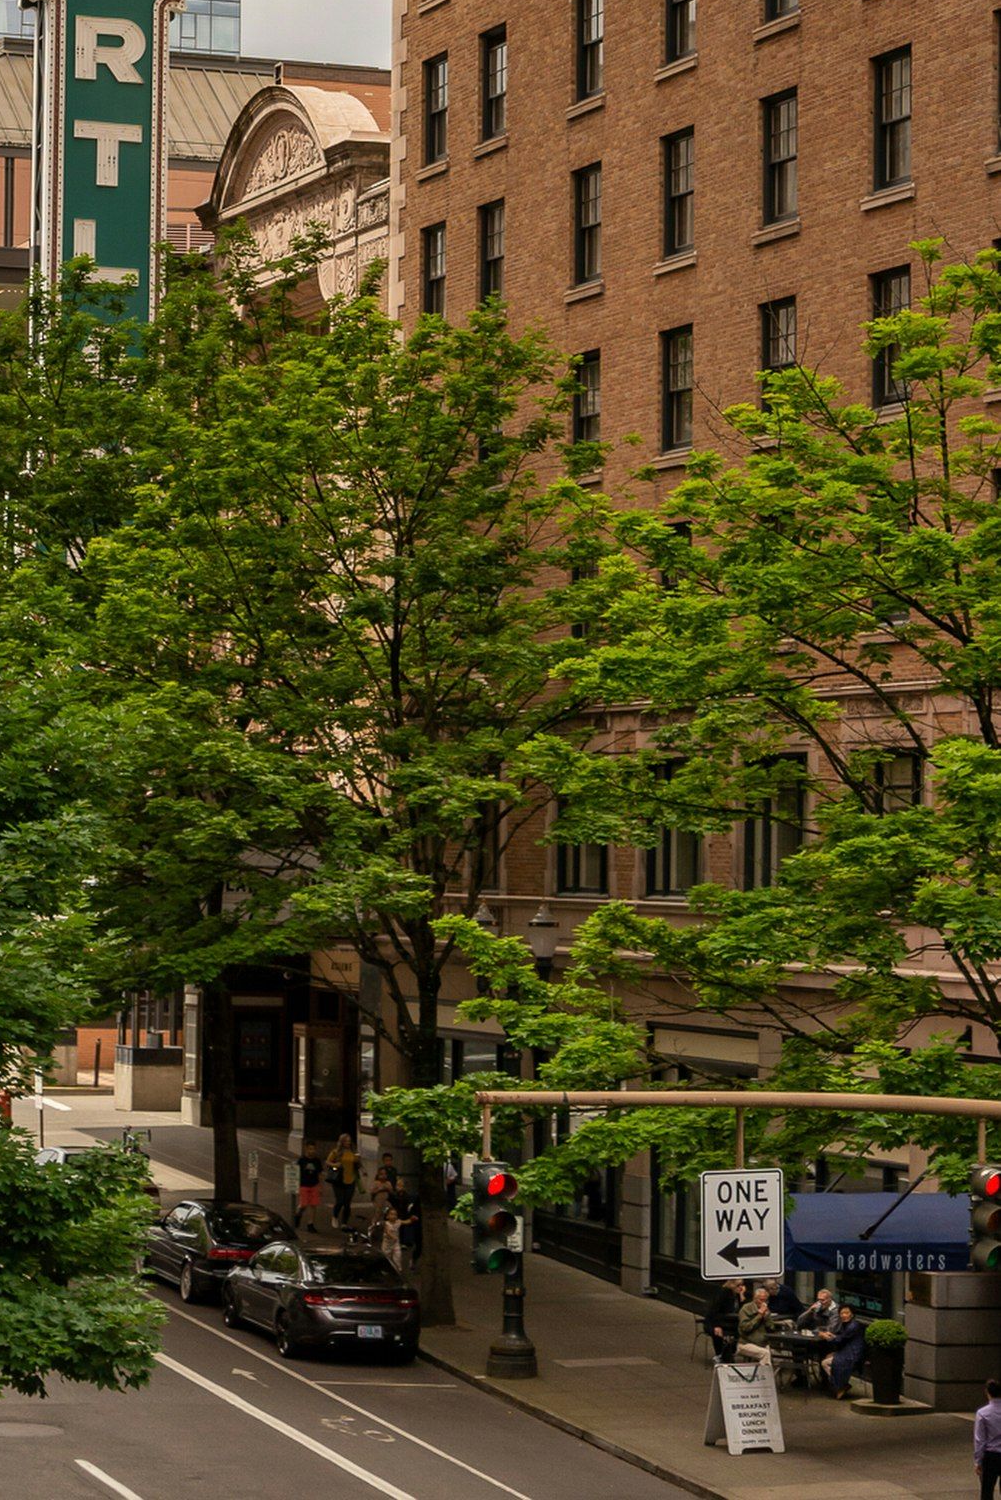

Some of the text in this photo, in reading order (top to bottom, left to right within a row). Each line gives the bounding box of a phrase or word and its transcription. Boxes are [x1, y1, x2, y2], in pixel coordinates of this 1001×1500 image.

[717, 1180, 768, 1204] ONE
[715, 1207, 770, 1232] WAY
[836, 1249, 946, 1271] headwaters
[731, 1402, 771, 1410] BREAKFAST
[741, 1419, 766, 1427] LUNCH
[741, 1428, 767, 1436] DINNER
